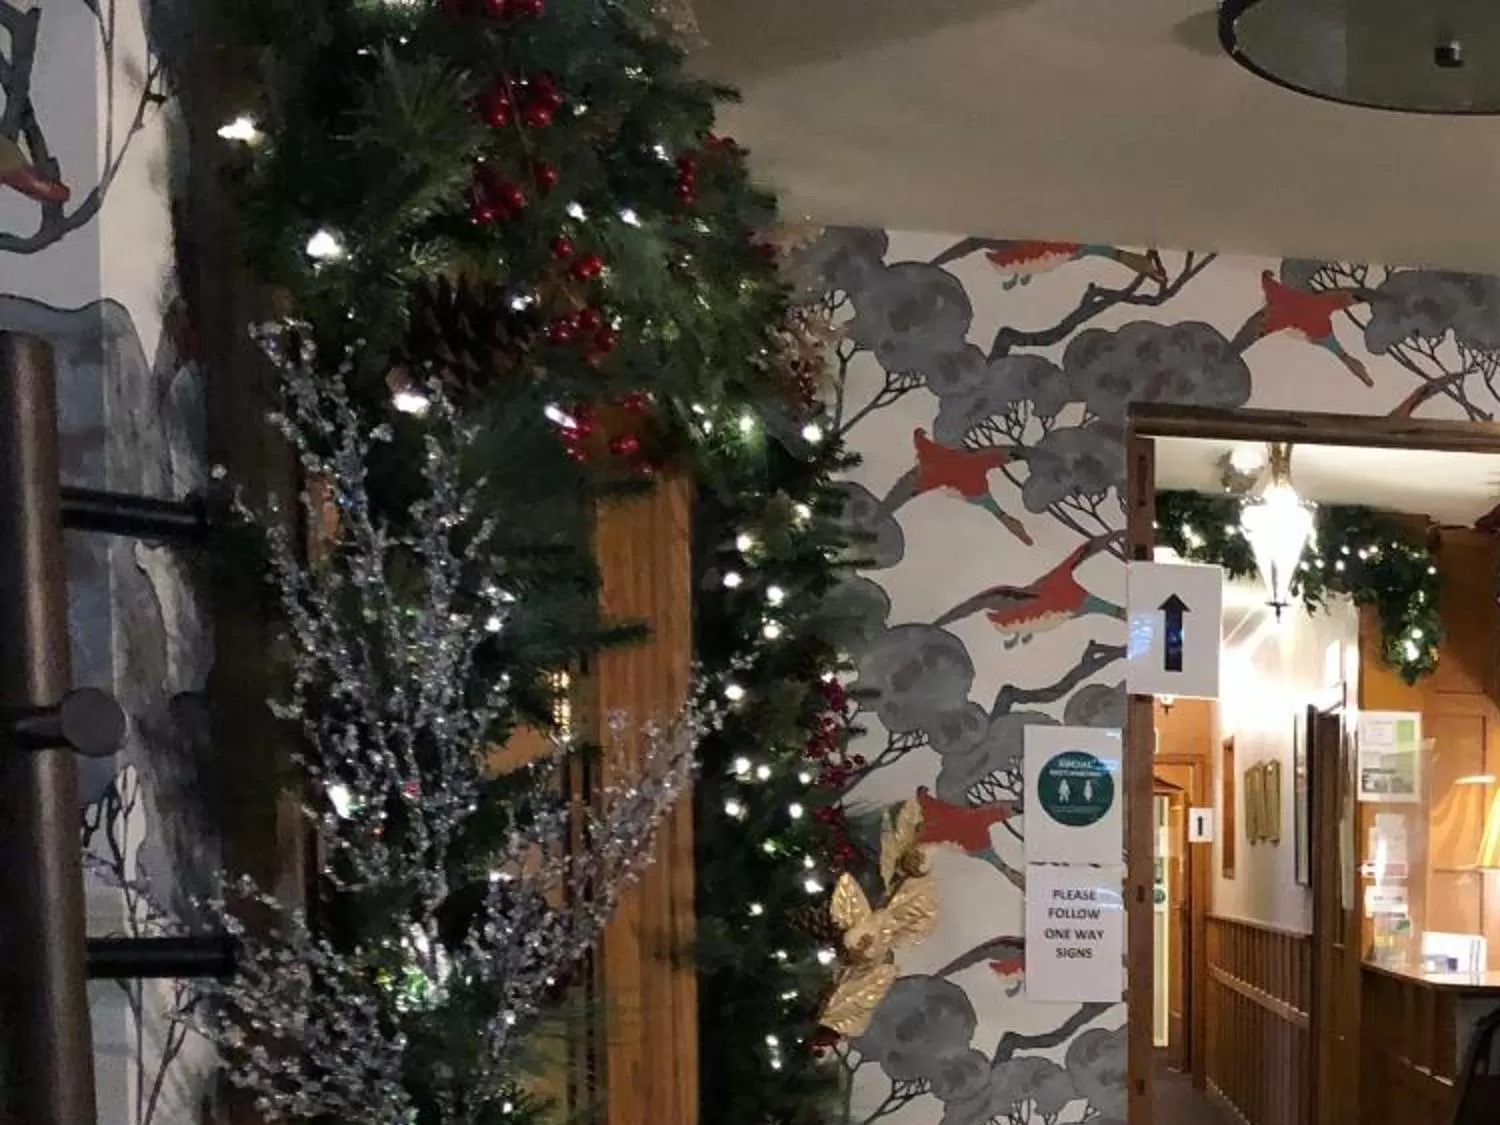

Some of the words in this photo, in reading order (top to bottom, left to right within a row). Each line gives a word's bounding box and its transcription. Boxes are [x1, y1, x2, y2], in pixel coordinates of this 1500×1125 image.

[1053, 889, 1097, 901] PLEASE
[1048, 907, 1101, 919] FOLLOW
[1044, 928, 1070, 940] ONE
[1074, 929, 1104, 941] WAY
[1055, 947, 1093, 959] SIGNS
